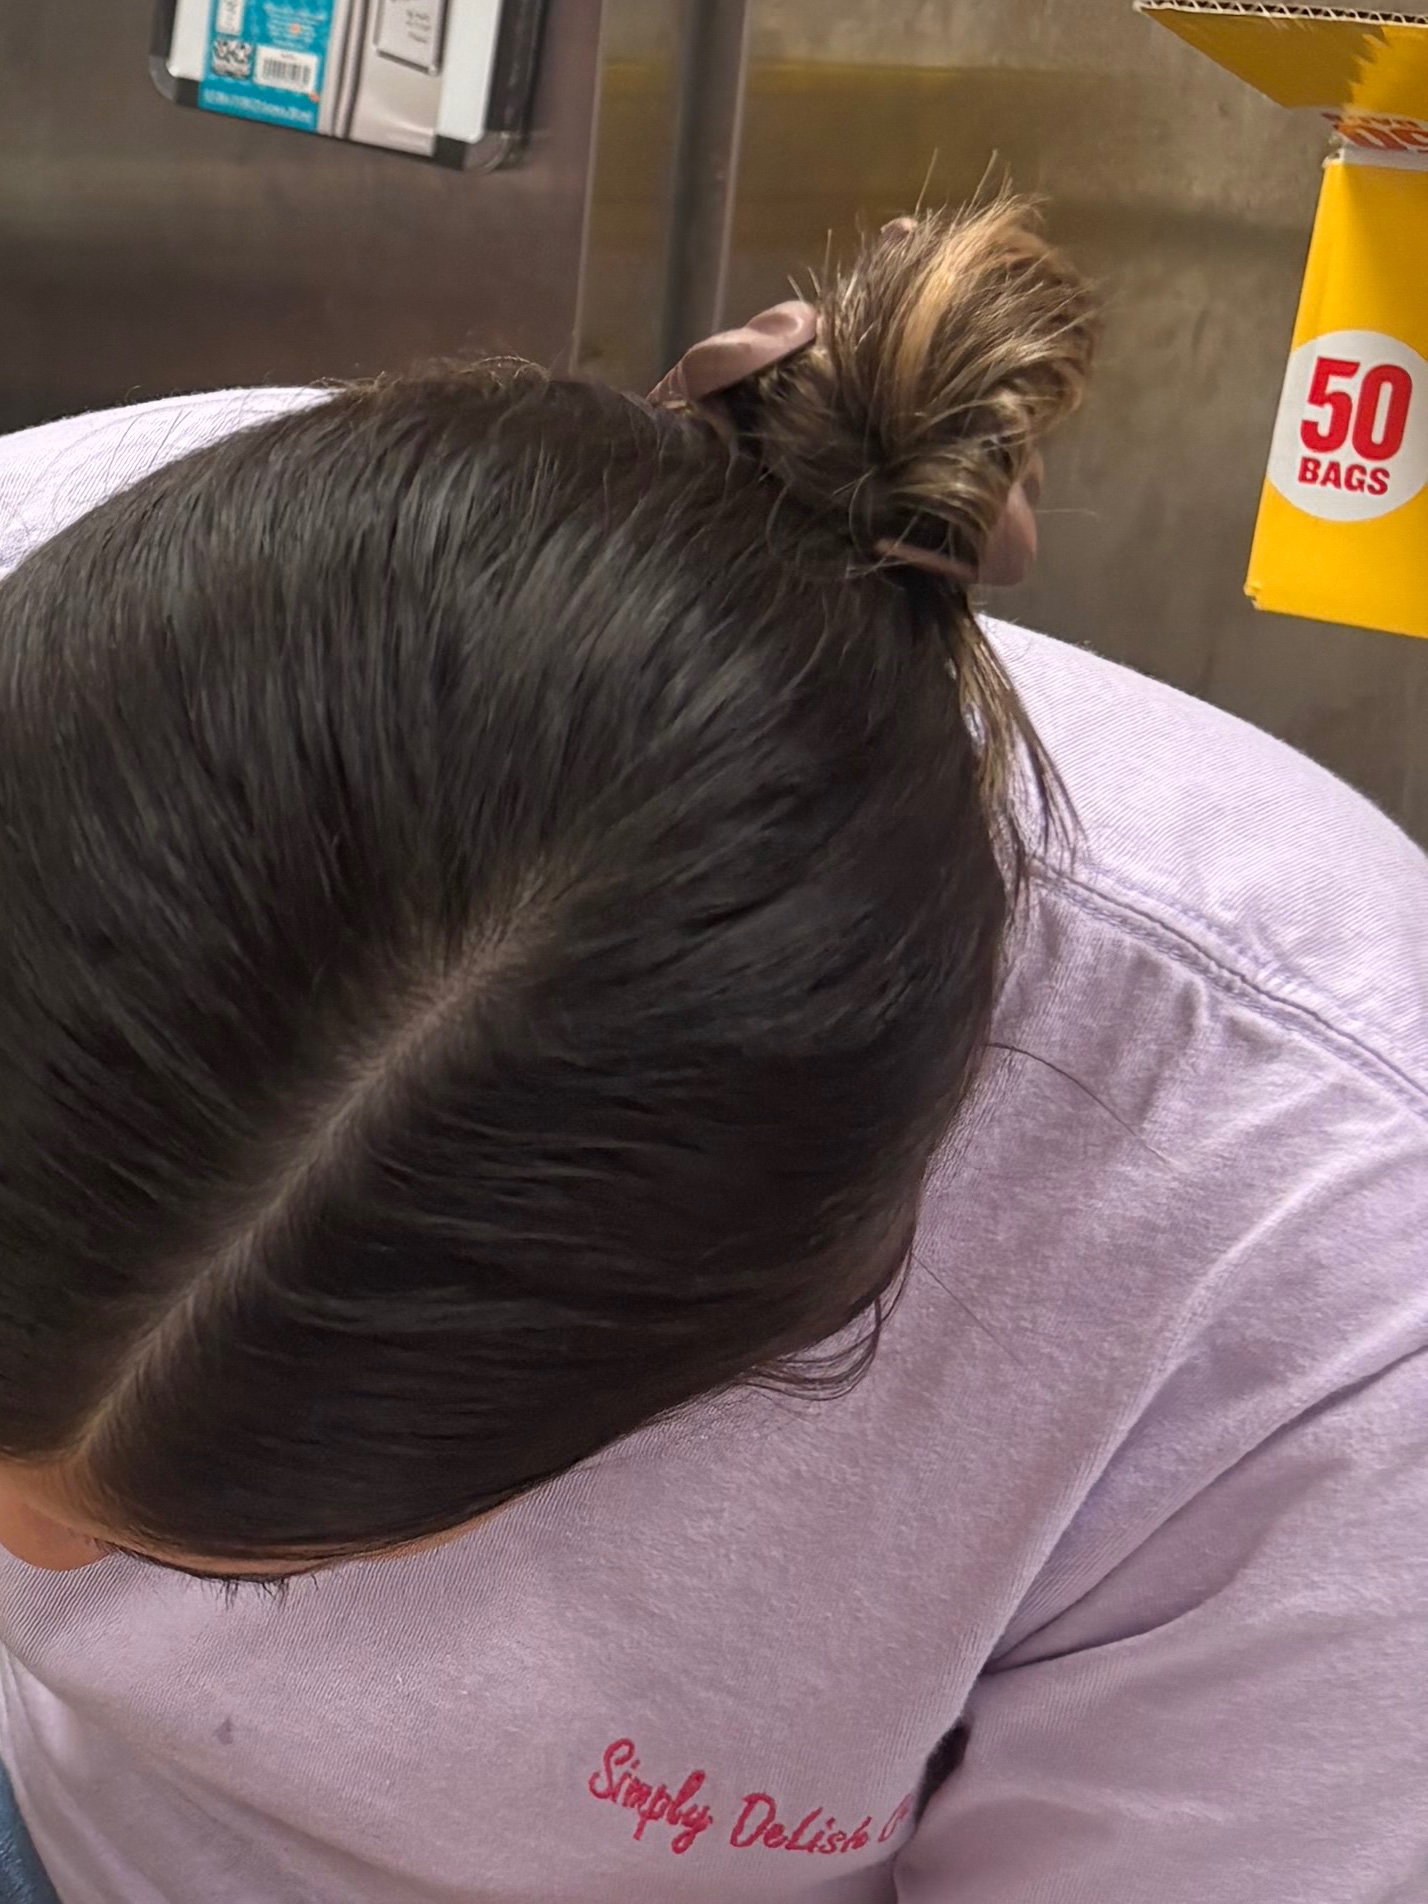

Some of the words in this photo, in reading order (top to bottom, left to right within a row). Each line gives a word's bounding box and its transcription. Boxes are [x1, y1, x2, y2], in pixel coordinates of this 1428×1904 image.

[1300, 356, 1413, 461] 50
[1298, 456, 1390, 496] BAGS
[588, 1737, 713, 1855] Simply
[729, 1792, 873, 1854] Delish
